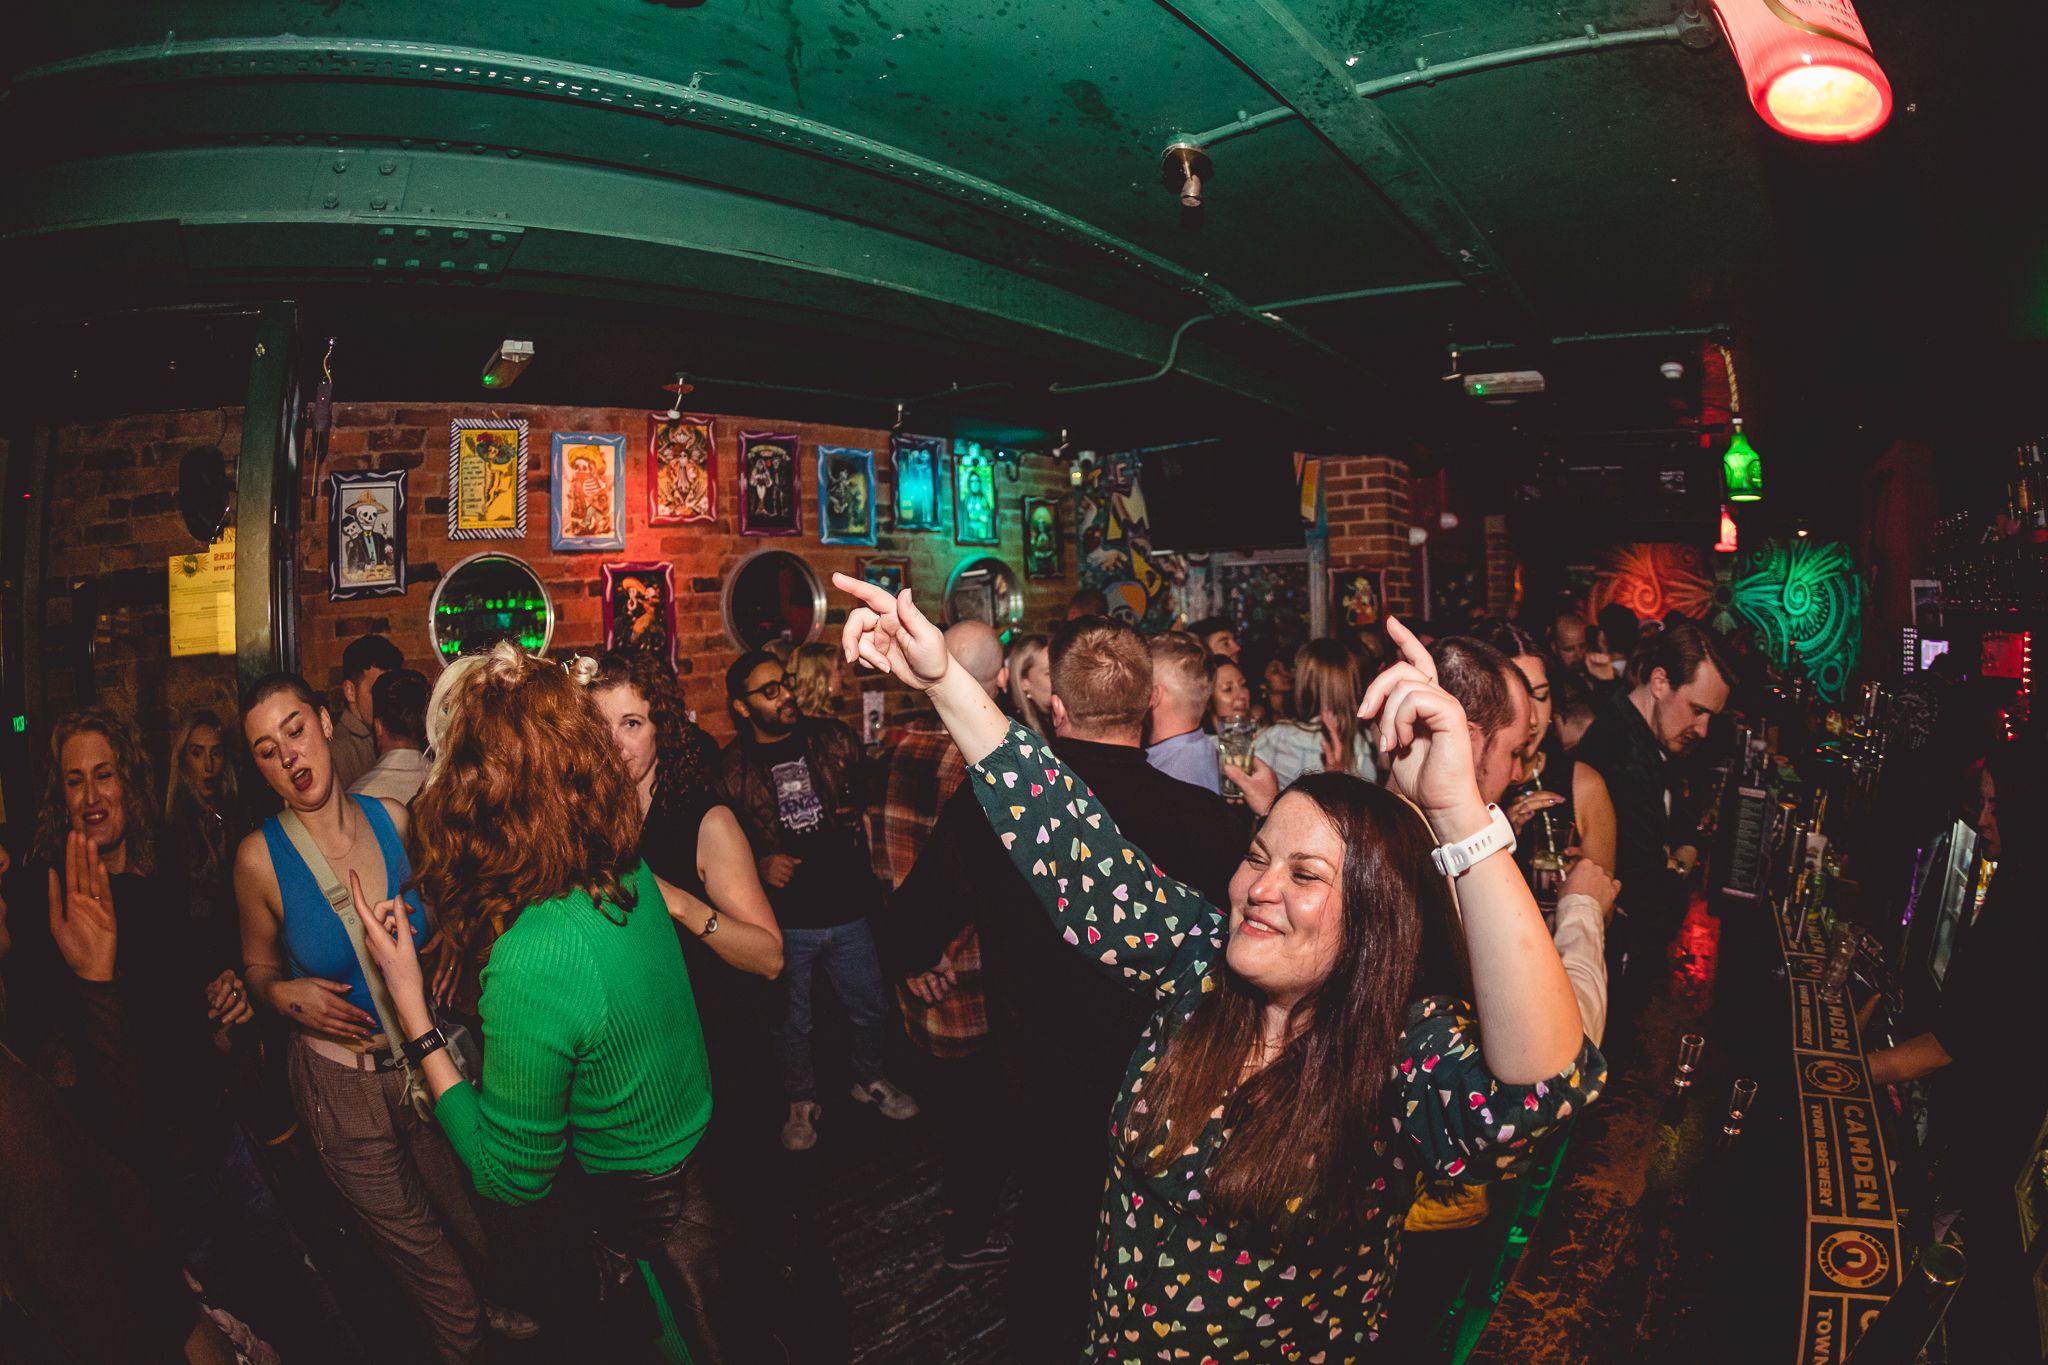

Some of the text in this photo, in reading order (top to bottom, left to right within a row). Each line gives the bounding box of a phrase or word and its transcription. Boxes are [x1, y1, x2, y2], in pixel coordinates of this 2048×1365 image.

[1810, 1103, 1833, 1208] TOWN BREWERY
[1843, 1104, 1881, 1211] CAMDEN
